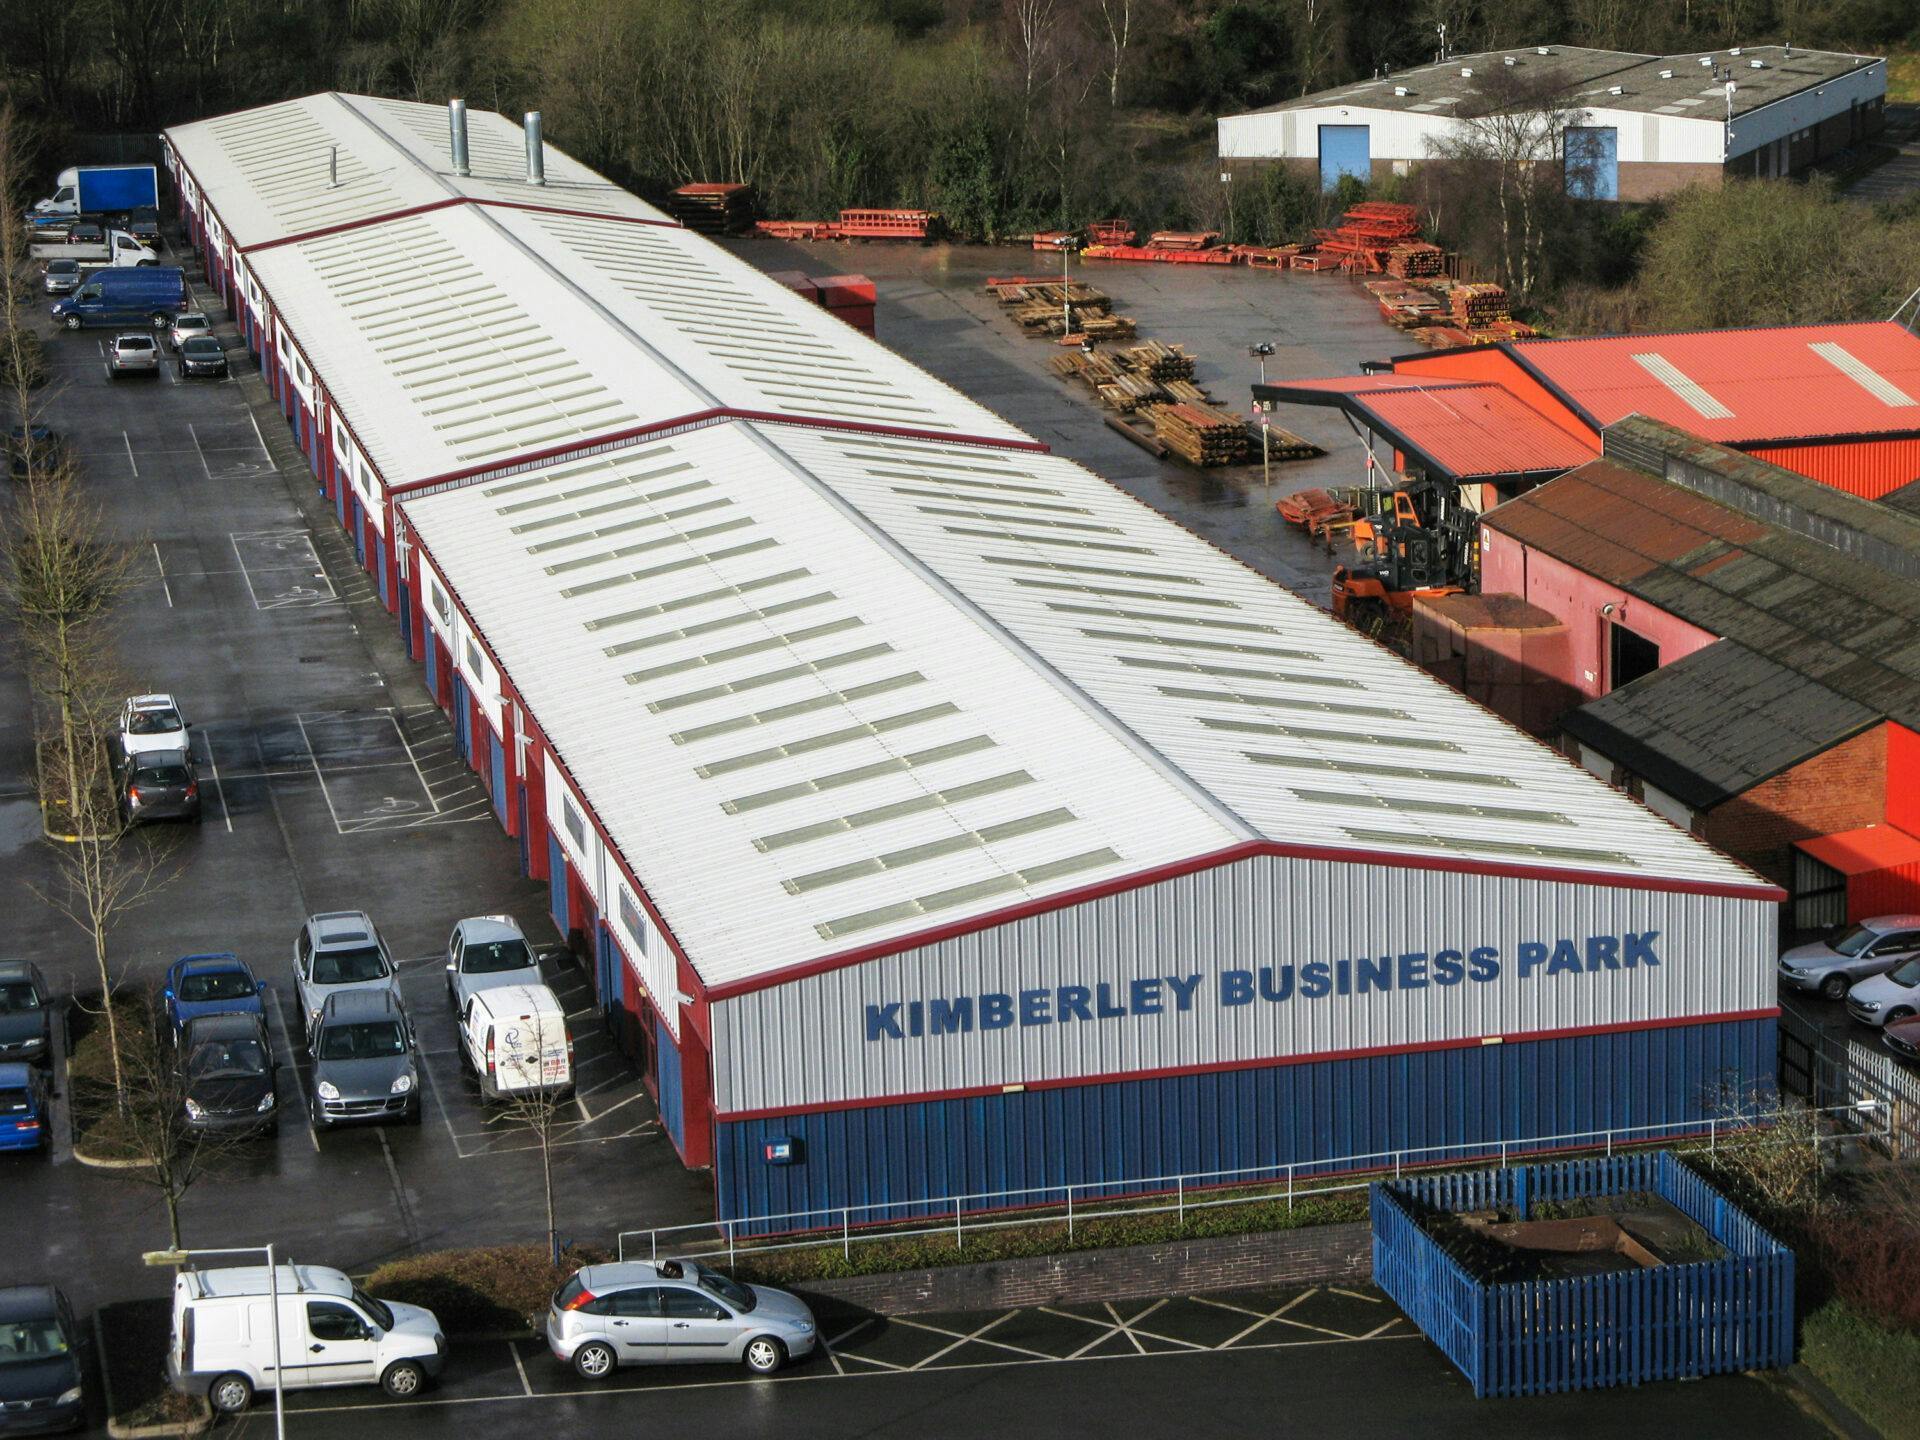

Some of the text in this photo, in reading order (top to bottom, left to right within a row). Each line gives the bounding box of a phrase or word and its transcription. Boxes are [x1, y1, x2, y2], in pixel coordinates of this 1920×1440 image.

[865, 930, 1661, 1041] KIMBERLEY BUSINESS PARK
